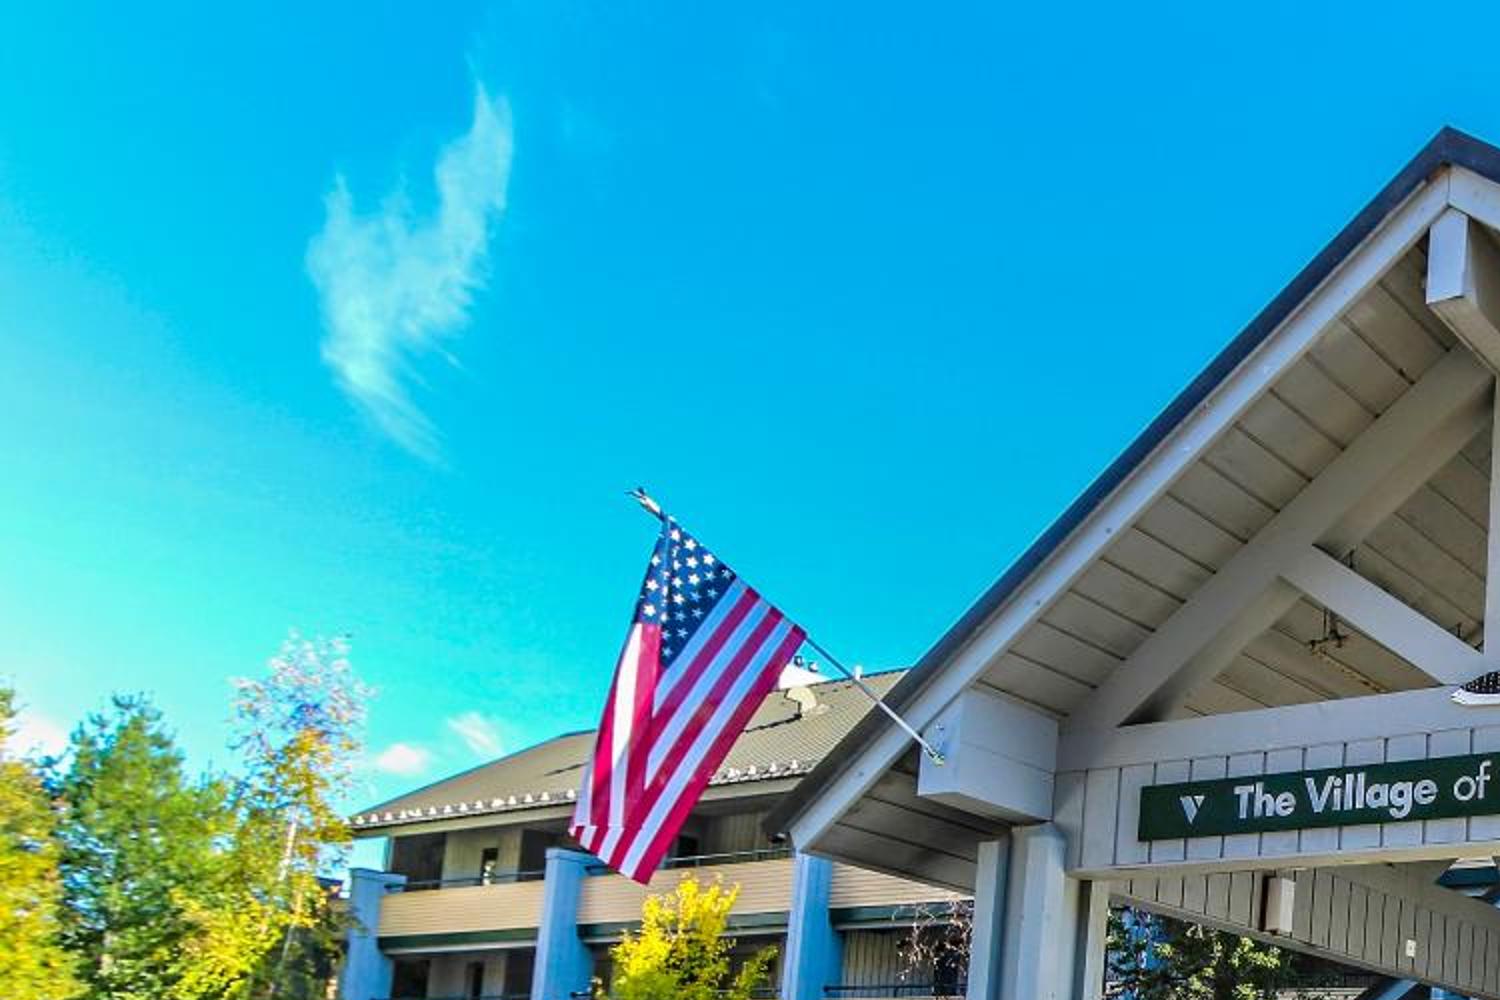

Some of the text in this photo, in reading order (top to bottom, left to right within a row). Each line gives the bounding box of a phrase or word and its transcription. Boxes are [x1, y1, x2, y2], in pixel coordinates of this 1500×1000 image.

[1234, 782, 1297, 819] The
[1305, 772, 1438, 818] Village
[1453, 760, 1492, 801] of
